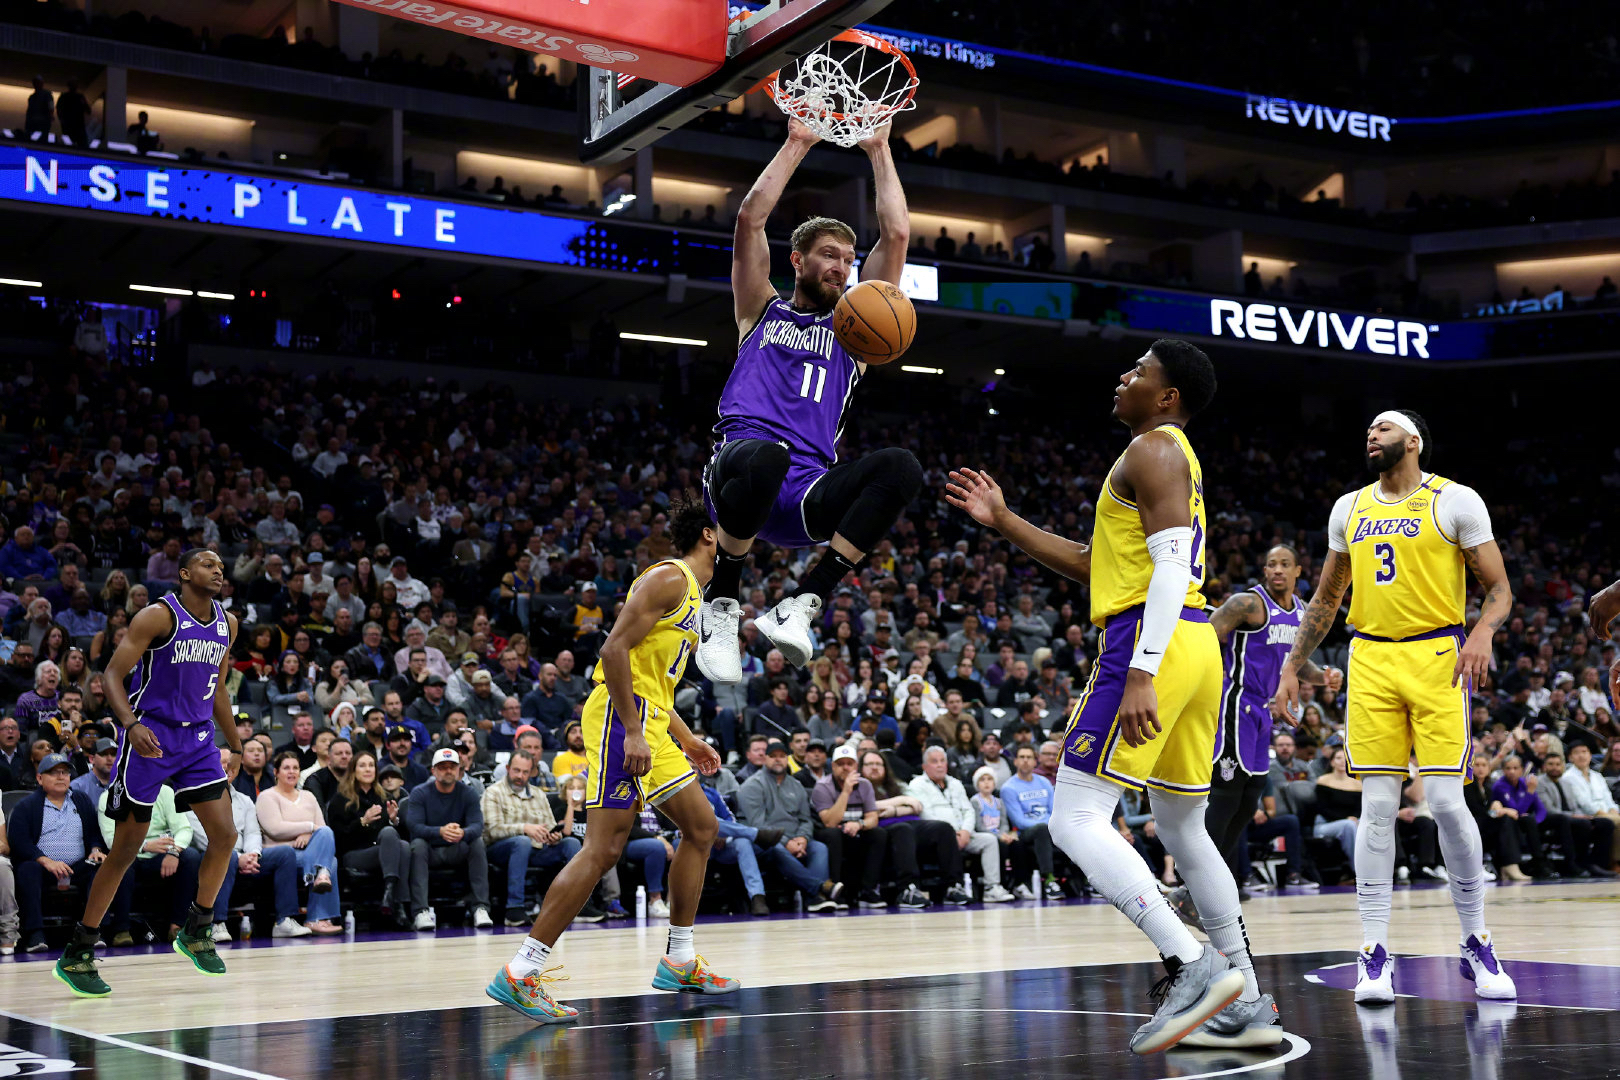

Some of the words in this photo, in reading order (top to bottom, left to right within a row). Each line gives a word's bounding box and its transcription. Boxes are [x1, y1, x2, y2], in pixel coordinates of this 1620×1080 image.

[1245, 94, 1393, 142] REVIVER
[233, 182, 456, 244] PLATE
[758, 319, 835, 361] SACRAMENTO
[1210, 299, 1430, 359] REVIVER
[800, 361, 827, 404] 11
[1350, 516, 1422, 544] LAKERS
[1374, 542, 1397, 586] 3
[202, 673, 219, 701] 5
